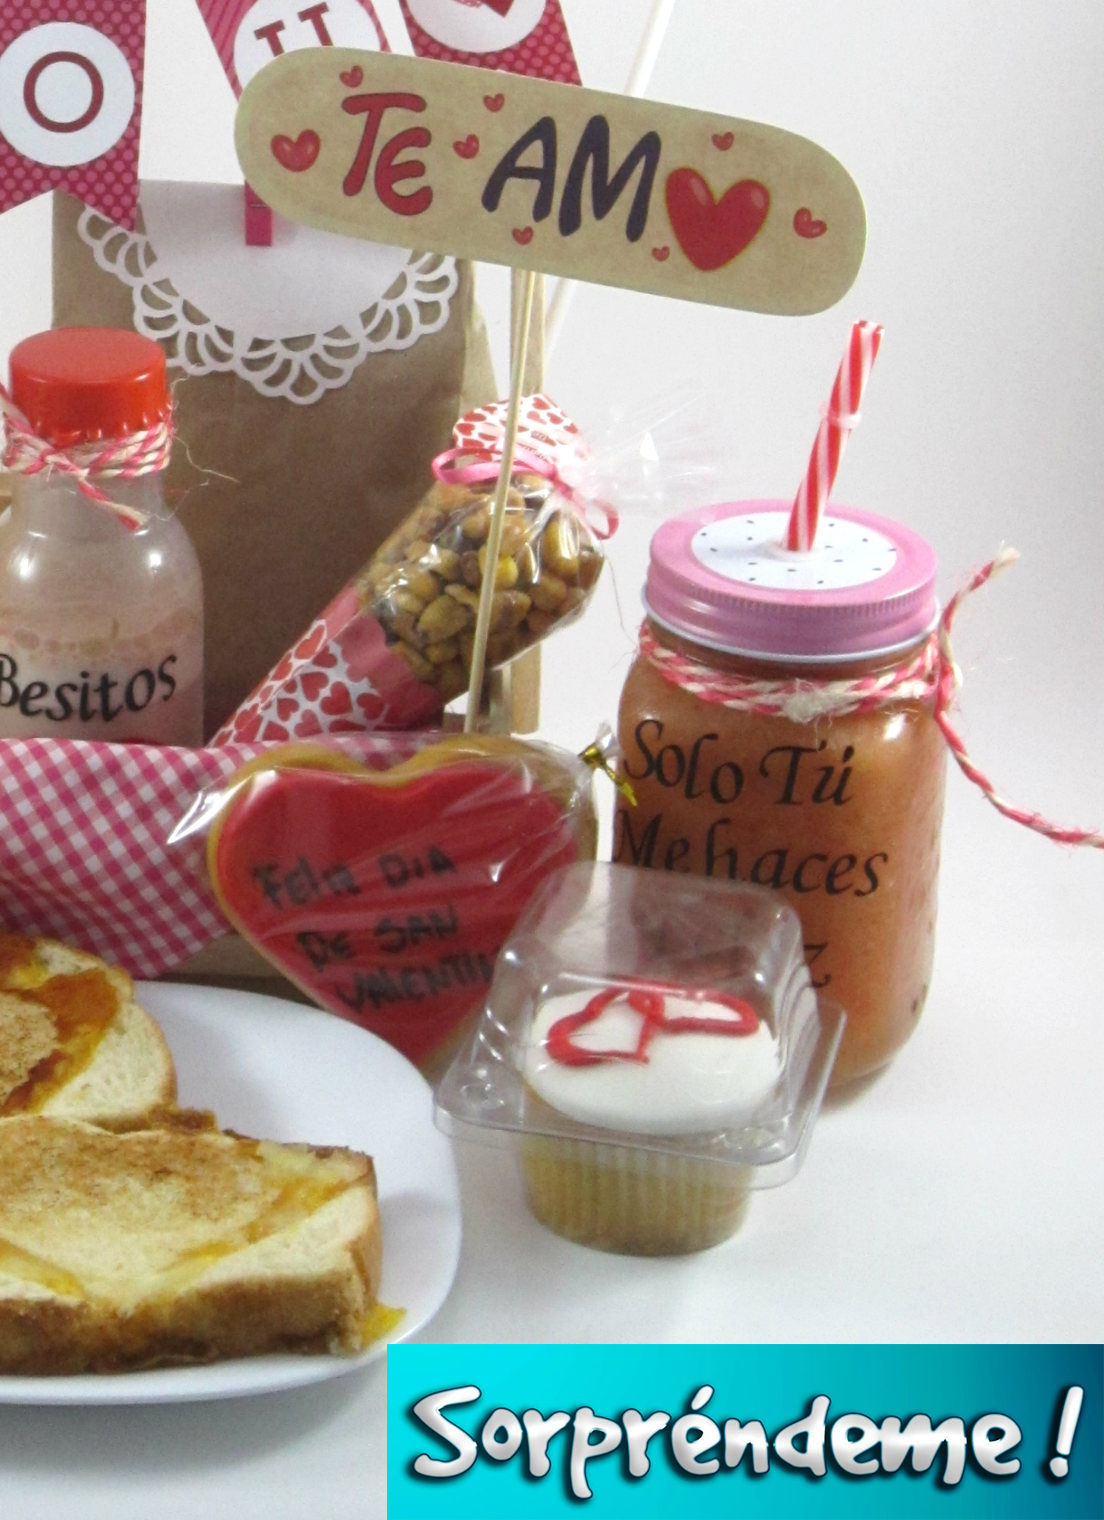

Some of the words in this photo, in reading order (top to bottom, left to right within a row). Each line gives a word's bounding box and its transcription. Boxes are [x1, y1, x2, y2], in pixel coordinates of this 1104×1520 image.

[341, 91, 434, 216] TE
[623, 719, 745, 805] Solo
[759, 740, 855, 806] Tú
